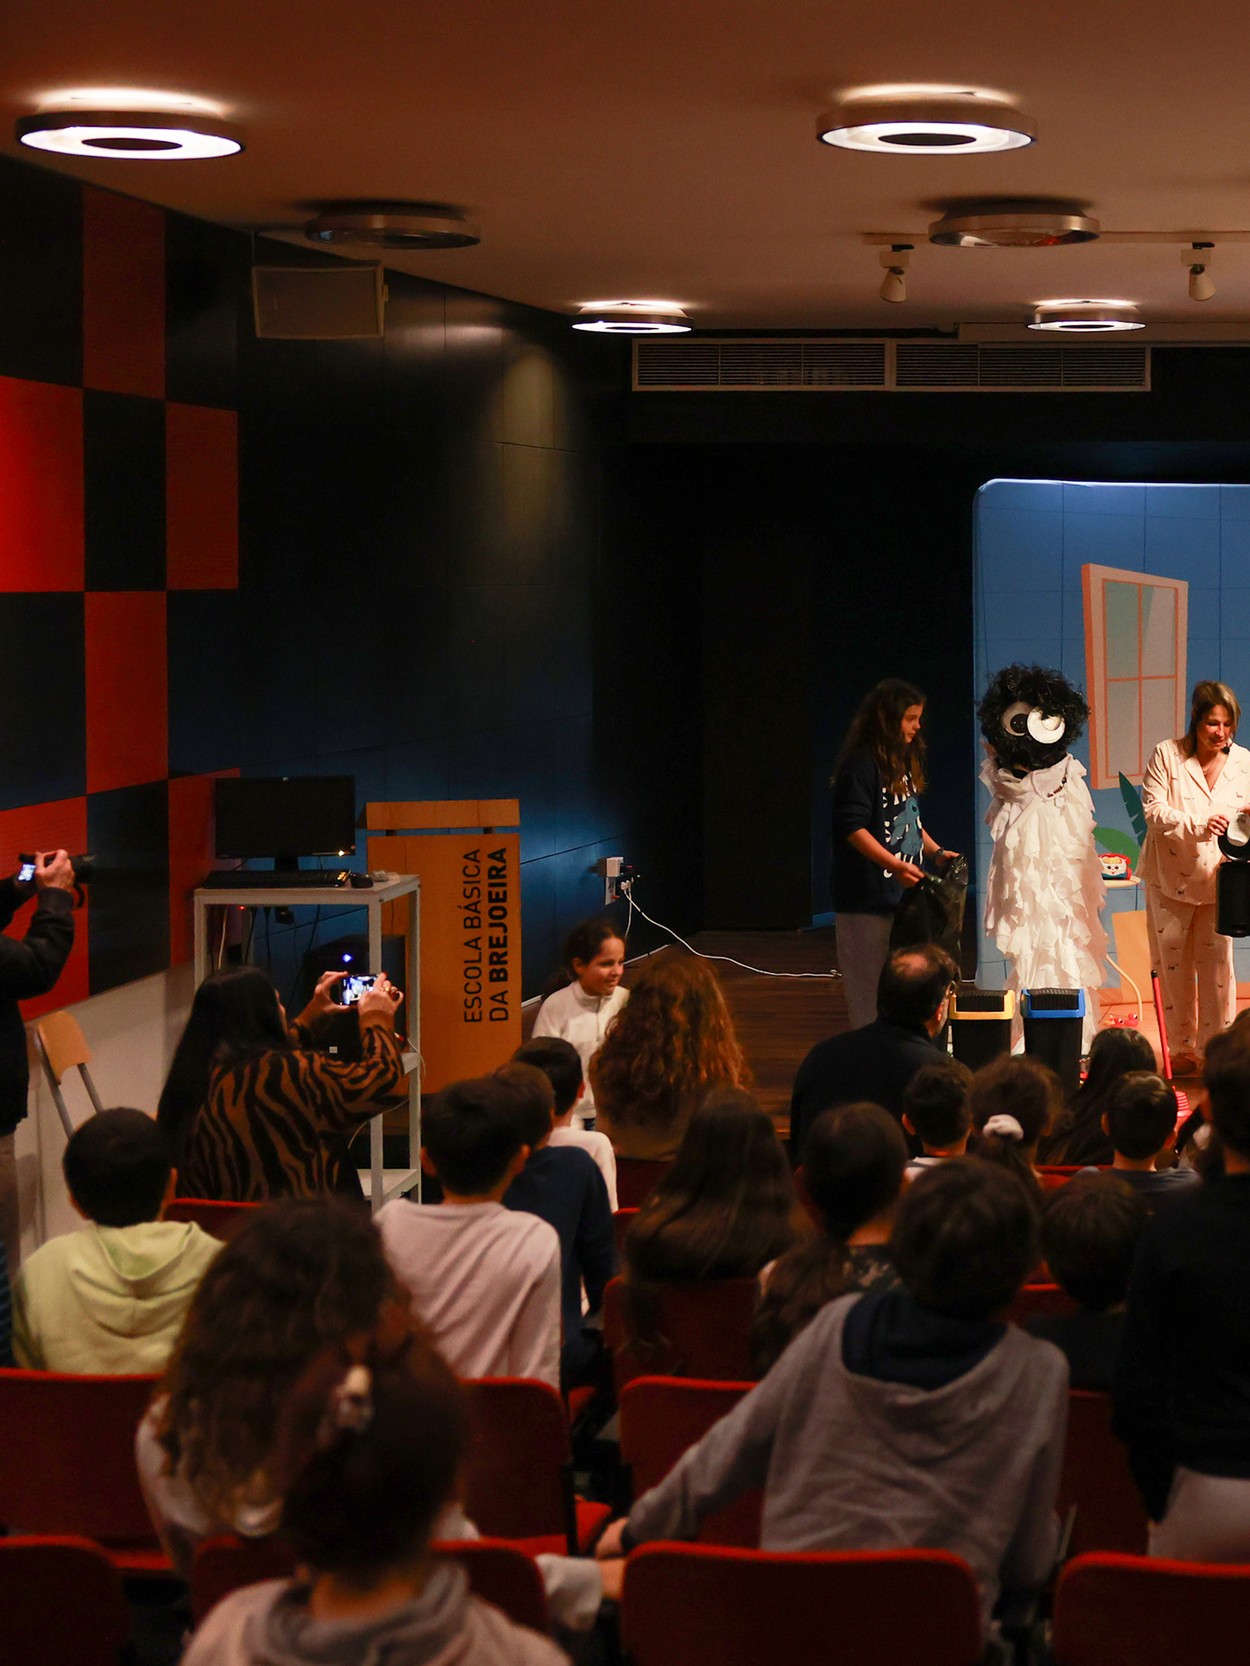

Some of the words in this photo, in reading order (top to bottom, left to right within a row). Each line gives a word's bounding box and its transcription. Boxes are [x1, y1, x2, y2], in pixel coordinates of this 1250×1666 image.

[457, 849, 482, 929] BÁSICA
[487, 848, 508, 982] BREJOEIRA
[463, 936, 482, 1023] ESCOLA
[489, 989, 509, 1022] DA
